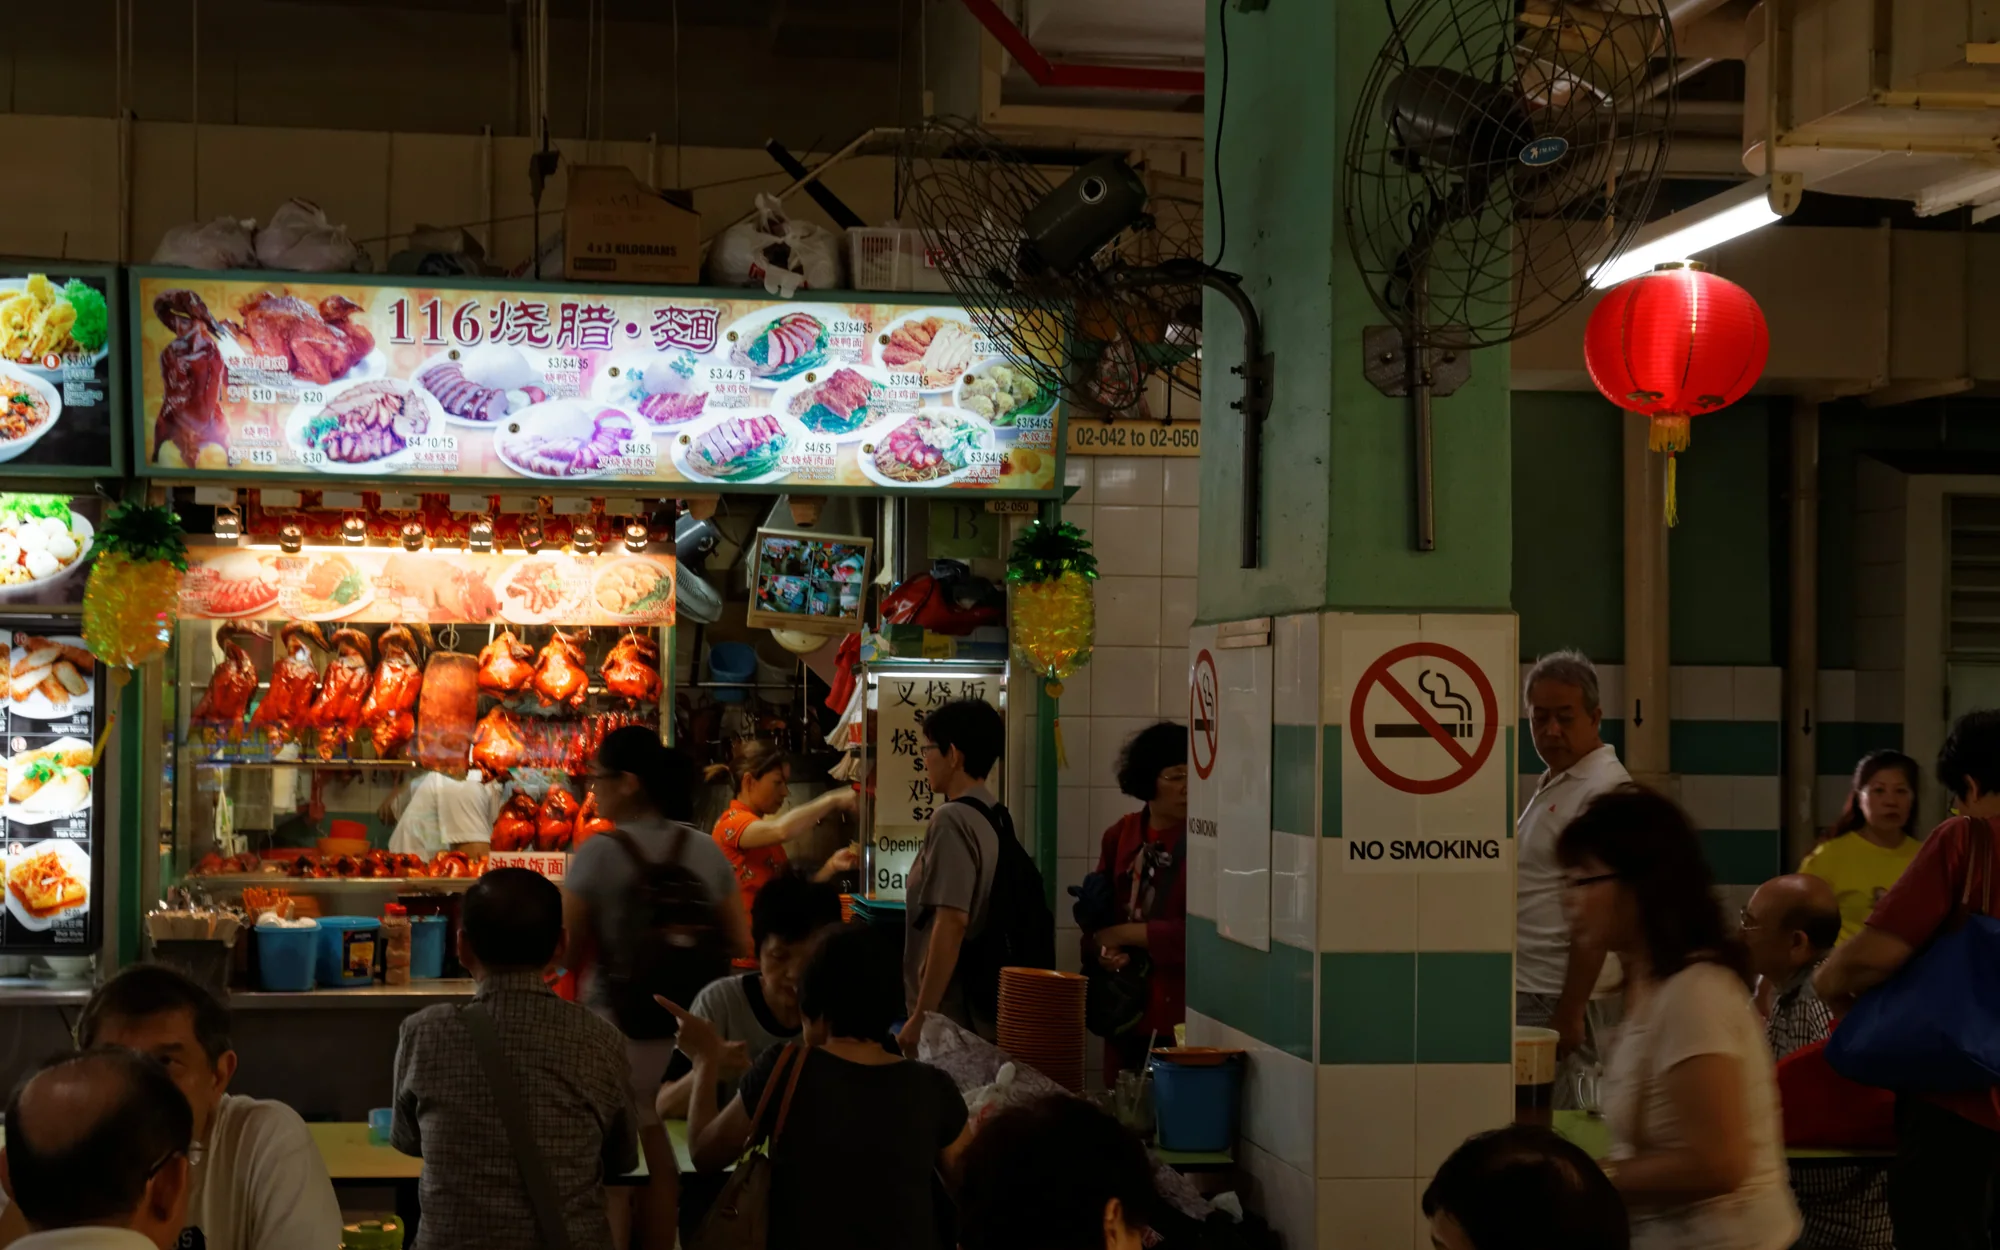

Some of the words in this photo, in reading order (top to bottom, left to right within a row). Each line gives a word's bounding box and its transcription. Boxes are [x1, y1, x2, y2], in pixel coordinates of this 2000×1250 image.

[615, 244, 677, 256] KILOGRAMS
[834, 321, 873, 334] $3/$4/$5
[548, 357, 589, 370] $3/$4/$5
[710, 368, 745, 380] $3/4/5
[889, 373, 929, 386] $3/$4/$5
[252, 388, 271, 400] $10
[303, 391, 323, 403] $20
[1016, 417, 1053, 430] $3/$4/$5
[1076, 427, 1127, 446] 02-042
[1130, 428, 1146, 447] to
[1150, 428, 1199, 448] 02-050
[625, 443, 651, 455] $4/$5
[804, 442, 832, 454] $4/$5
[252, 451, 273, 464] $15
[302, 453, 322, 465] $30
[970, 451, 1009, 464] $3/$4/$5
[994, 502, 1029, 512] 02-050
[1197, 818, 1218, 838] SMOKIN
[1350, 840, 1384, 860] NO
[1390, 839, 1500, 859] SMOKING
[878, 868, 908, 889] 9a
